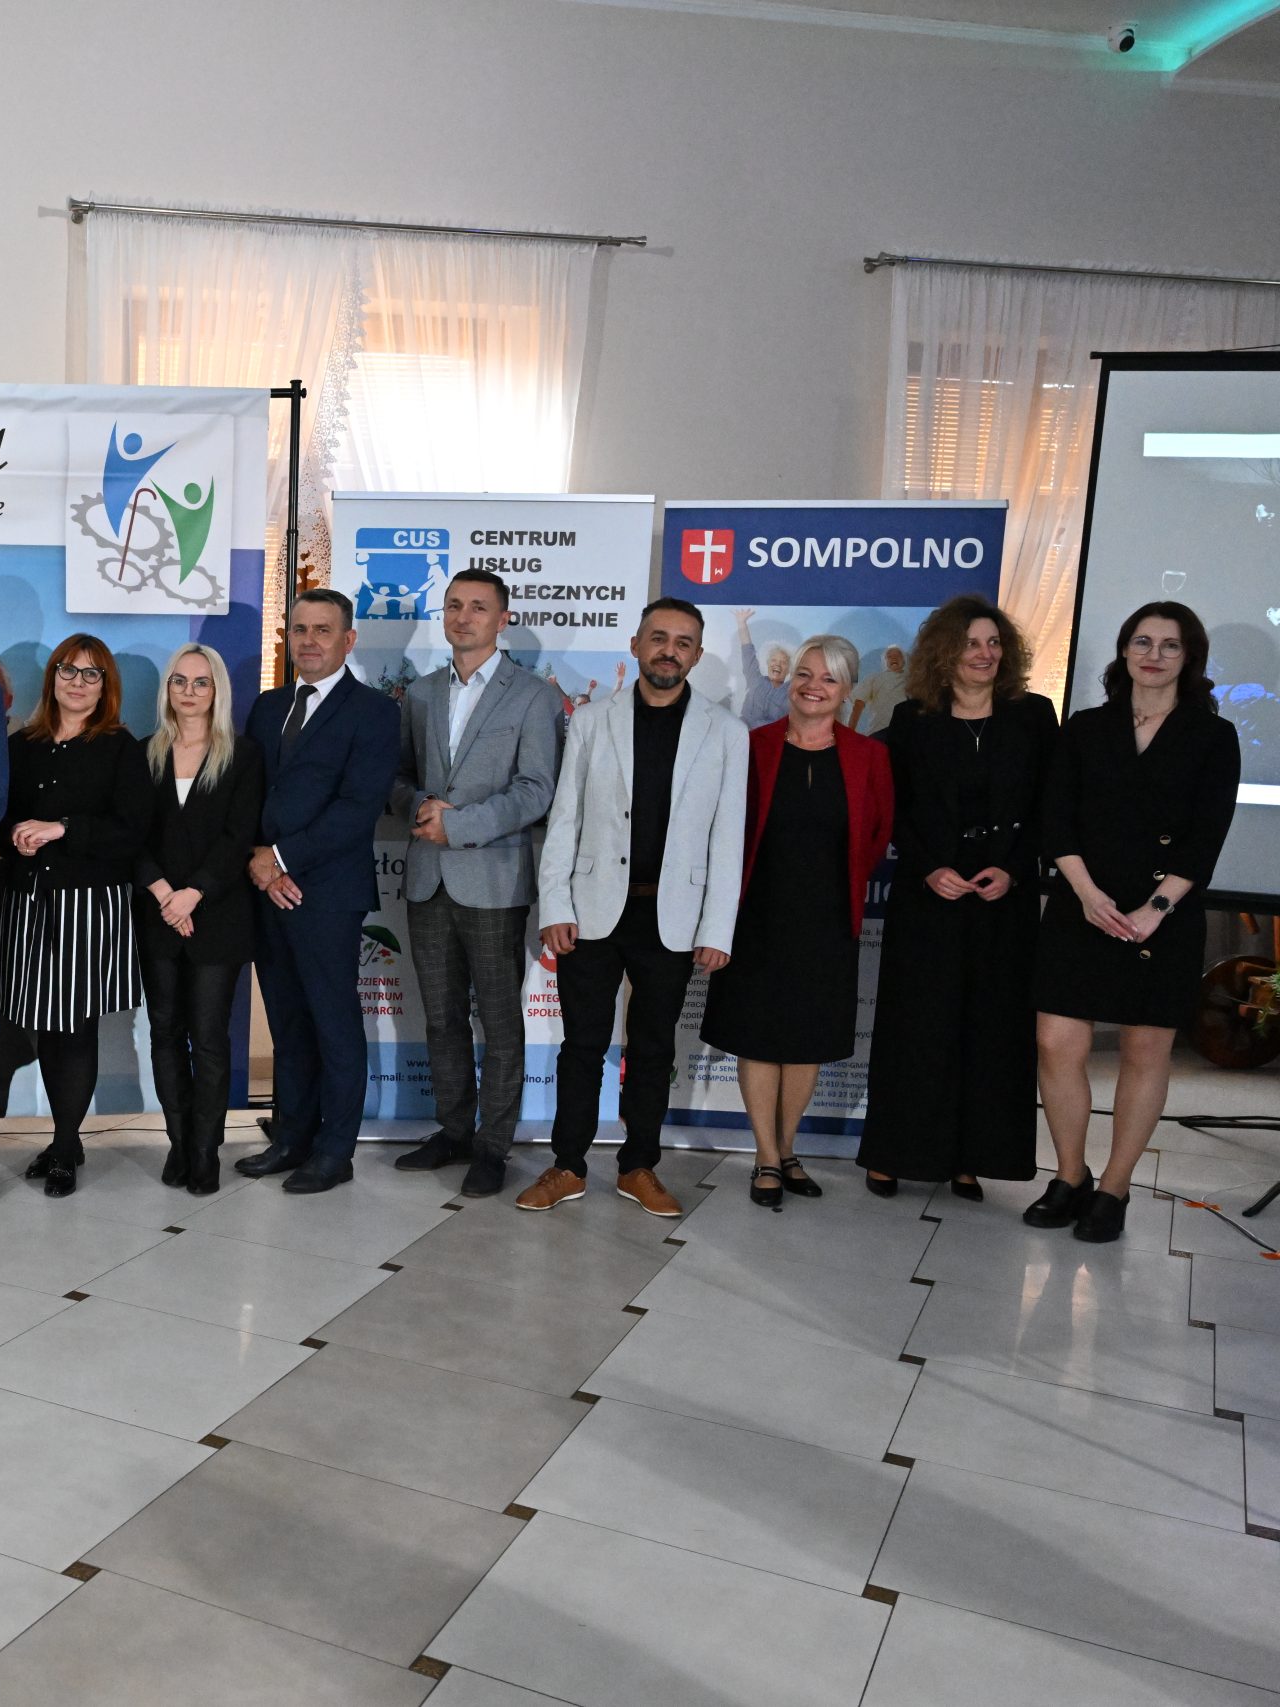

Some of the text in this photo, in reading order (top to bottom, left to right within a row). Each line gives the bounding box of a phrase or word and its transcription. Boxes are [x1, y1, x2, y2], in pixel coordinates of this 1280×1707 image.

[392, 530, 441, 548] CUS
[469, 530, 577, 547] CENTRUM
[747, 536, 984, 569] SOMPOLNO
[469, 557, 543, 573] USŁUG
[508, 584, 626, 601] ŁECZNYCH
[369, 1073, 405, 1082] e-mail:
[697, 1073, 739, 1083] SOMPOLNI
